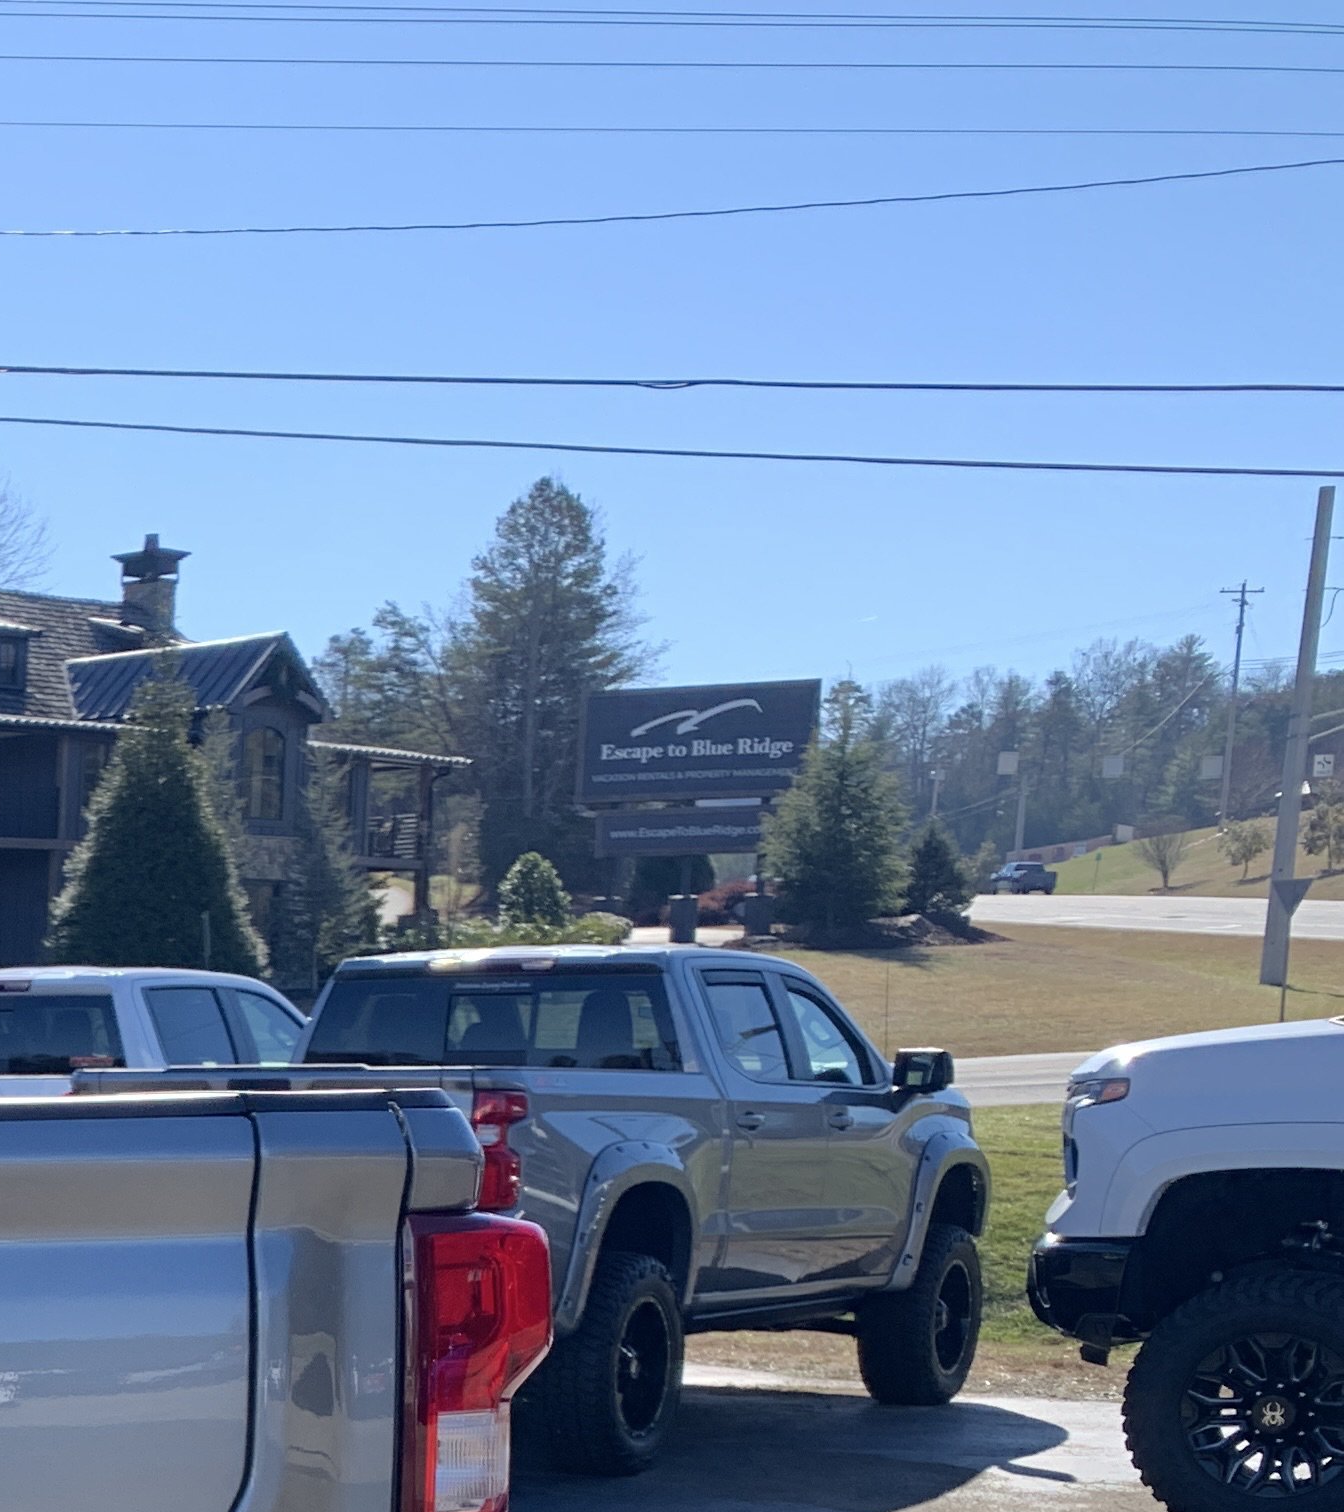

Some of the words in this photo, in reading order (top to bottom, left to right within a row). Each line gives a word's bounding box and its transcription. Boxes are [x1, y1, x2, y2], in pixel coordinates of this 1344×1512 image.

[601, 744, 663, 763] Escape
[667, 745, 687, 757] to
[691, 739, 733, 757] Blue
[737, 737, 794, 758] Ridge
[609, 825, 761, 839] www.EscapeToBlueRidge.co
